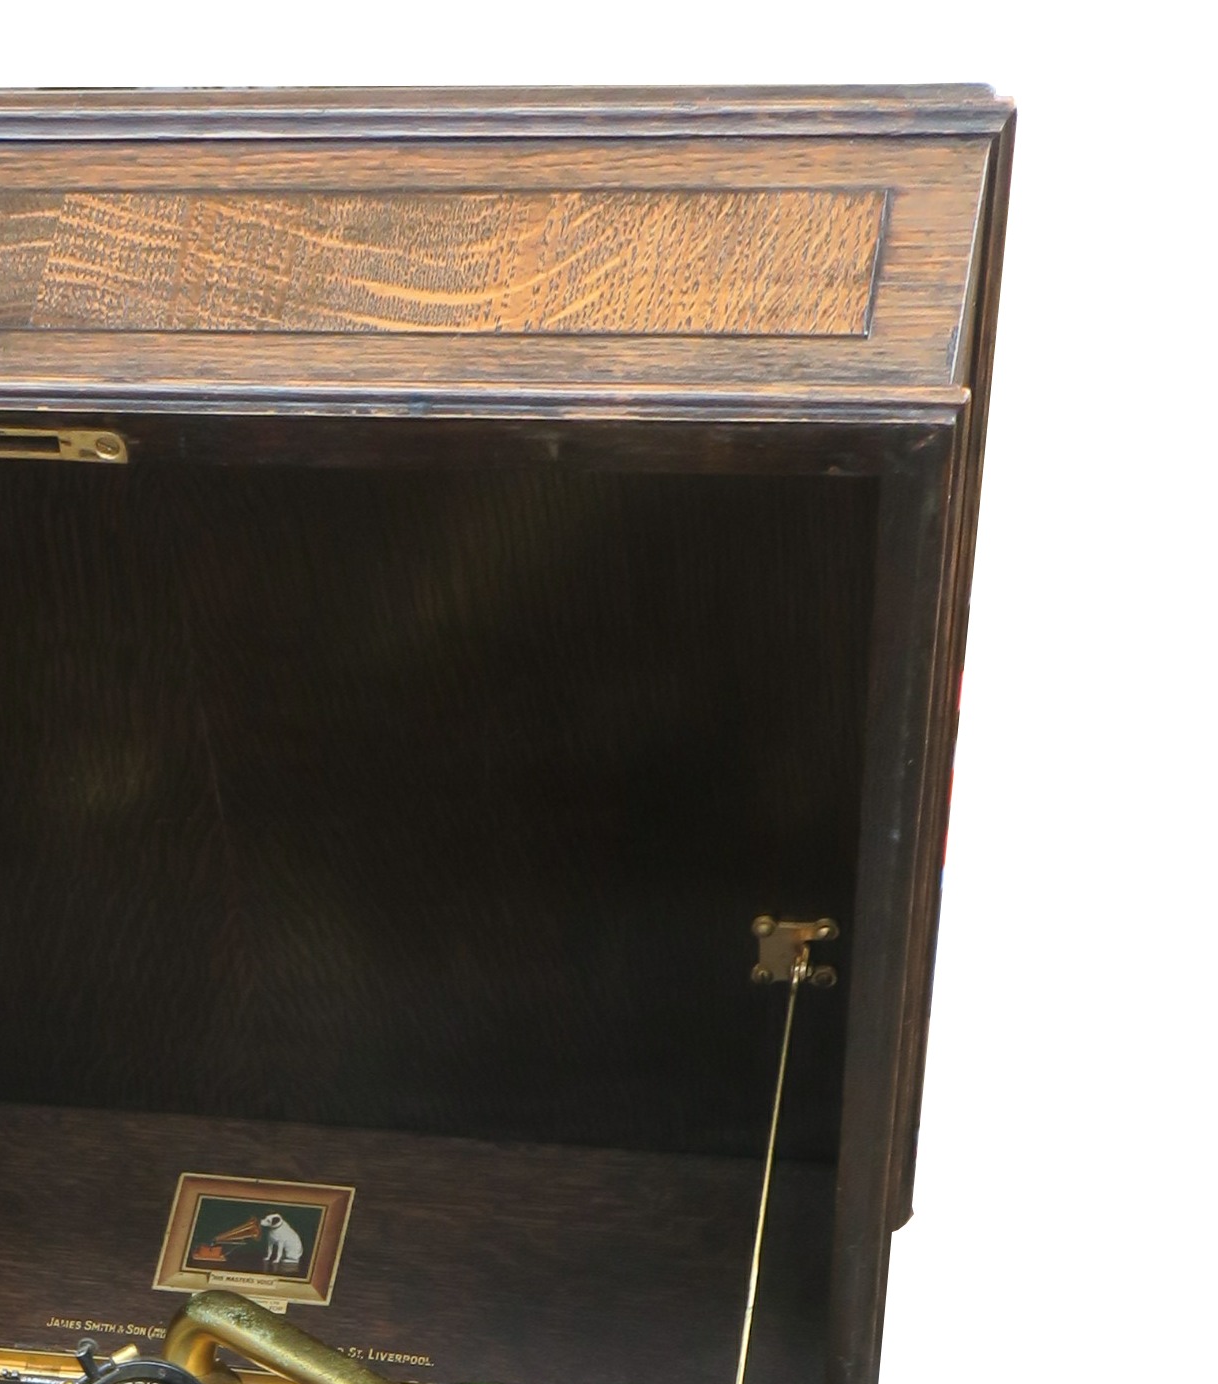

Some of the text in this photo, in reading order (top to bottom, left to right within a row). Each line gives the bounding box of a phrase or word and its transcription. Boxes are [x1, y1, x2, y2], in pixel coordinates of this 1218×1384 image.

[84, 1320, 116, 1333] SMITH
[117, 1325, 124, 1333] &
[125, 1324, 146, 1336] SON
